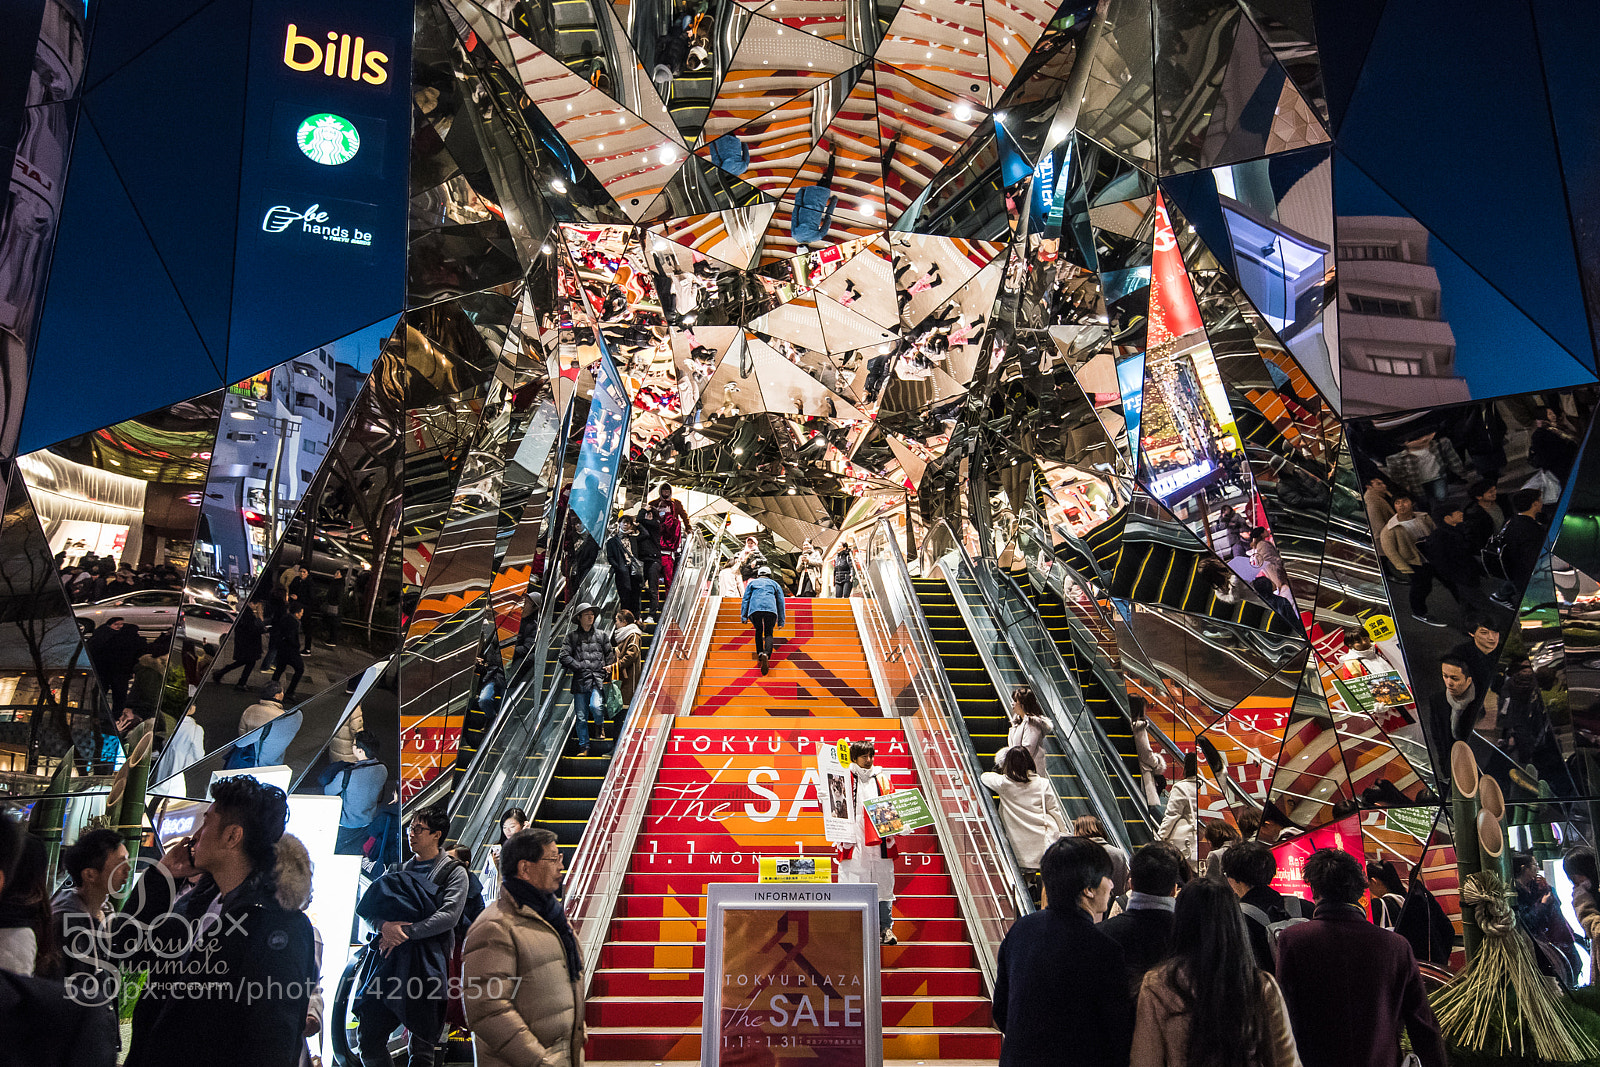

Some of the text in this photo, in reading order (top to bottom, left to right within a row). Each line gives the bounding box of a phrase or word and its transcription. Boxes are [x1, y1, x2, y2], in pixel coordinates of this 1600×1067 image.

[283, 23, 389, 85] bills
[303, 203, 330, 223] be
[302, 221, 372, 241] hands be
[673, 735, 782, 753] TOKYU
[653, 757, 736, 825] the
[649, 841, 695, 865] 1.1
[709, 852, 763, 865] MON
[754, 892, 831, 901] INFORMATION
[724, 974, 861, 986] TOKYU PLAZA
[722, 988, 862, 1029] the SALE
[723, 1035, 744, 1048] 1.1
[766, 1035, 797, 1048] 1.31
